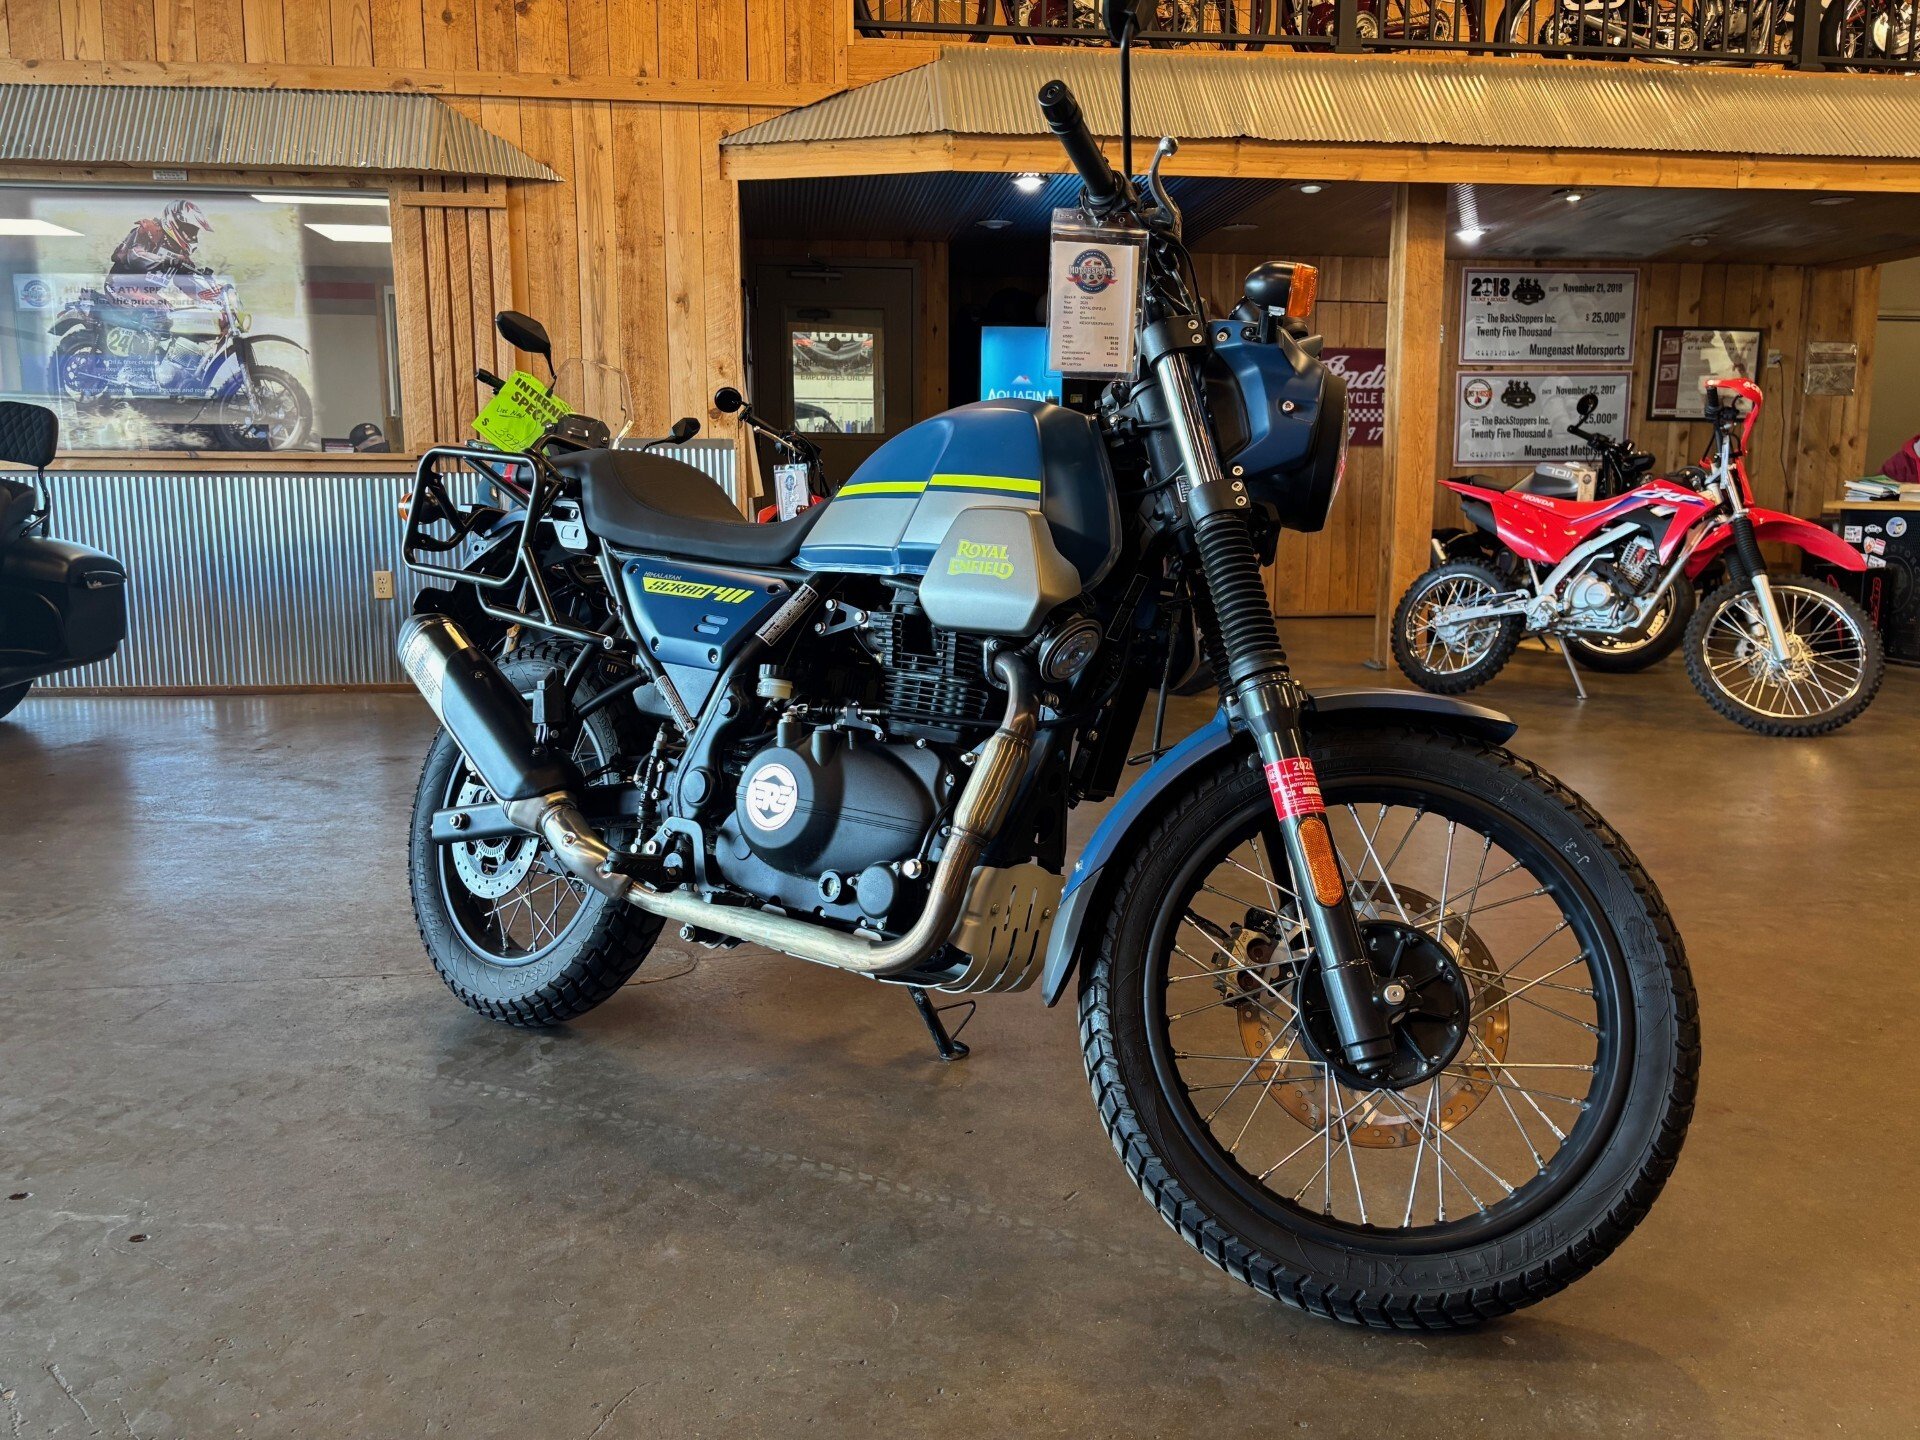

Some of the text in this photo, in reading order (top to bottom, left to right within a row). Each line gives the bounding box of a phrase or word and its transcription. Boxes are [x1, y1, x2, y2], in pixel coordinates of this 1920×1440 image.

[118, 286, 140, 294] ATV
[1563, 283, 1595, 292] November
[1596, 284, 1606, 294] 21,
[118, 298, 130, 306] the
[131, 297, 156, 308] price
[1487, 314, 1498, 322] The
[1500, 314, 1544, 324] BackStoppers
[1545, 314, 1556, 323] Inc.
[1477, 326, 1552, 338] Twenty Five Thousand
[109, 332, 132, 352] 24
[1530, 344, 1625, 358] Mungenast Motorsports
[1556, 386, 1588, 394] November
[1601, 385, 1616, 394] 2017
[1482, 416, 1492, 425] The
[1494, 416, 1536, 426] BackStoppers
[1539, 416, 1550, 425] Inc.
[1471, 428, 1546, 440] Twenty Five Thousand
[1524, 445, 1568, 458] Mungenast
[1522, 494, 1555, 508] HONDA
[1631, 488, 1703, 502] CRF
[955, 540, 1009, 559] ROYAL
[947, 558, 1014, 580] ENFIELD
[644, 571, 682, 580] HIMALAYAN
[648, 580, 709, 597] SCRAM
